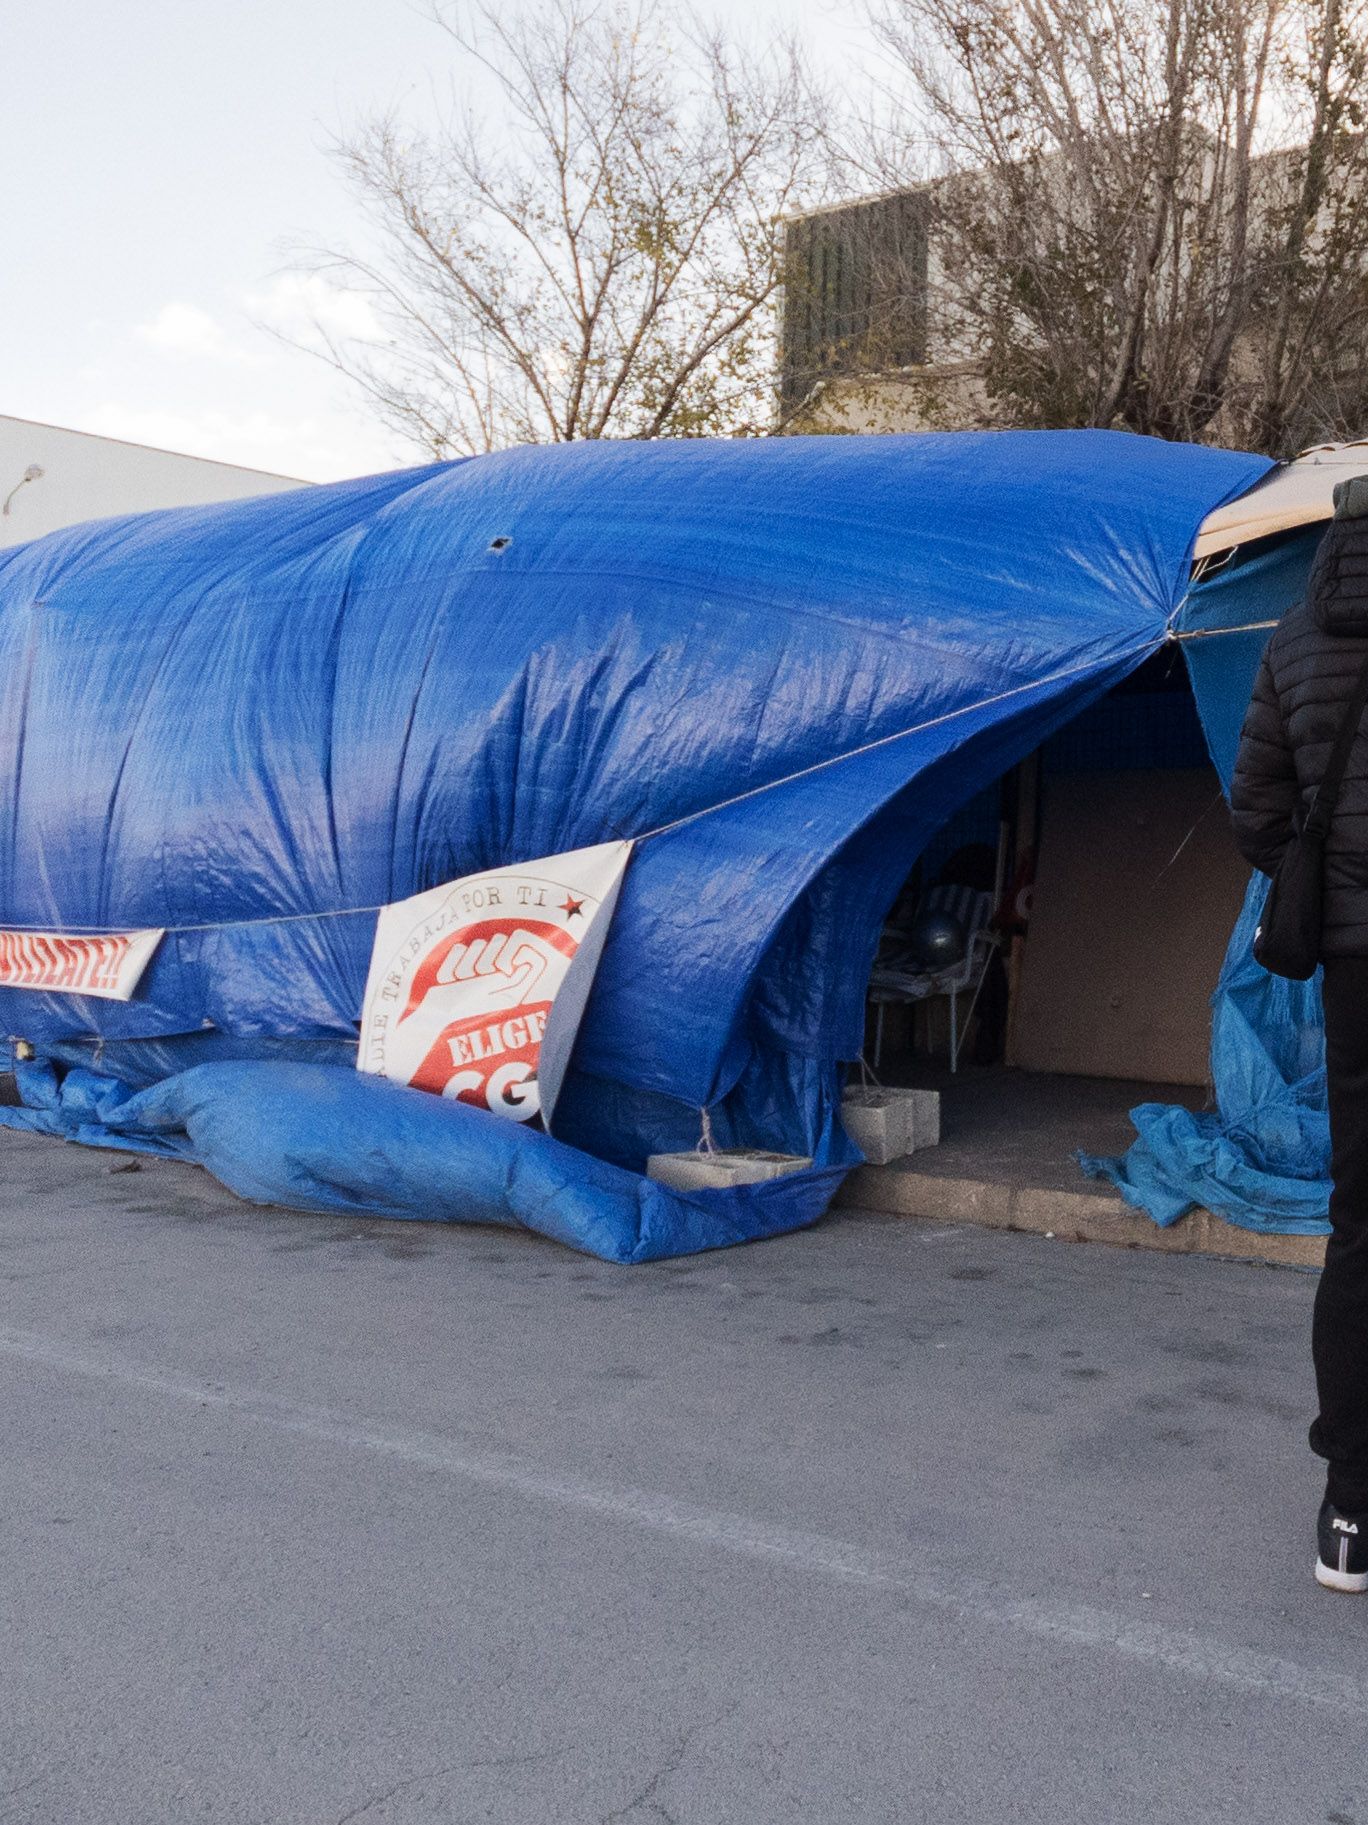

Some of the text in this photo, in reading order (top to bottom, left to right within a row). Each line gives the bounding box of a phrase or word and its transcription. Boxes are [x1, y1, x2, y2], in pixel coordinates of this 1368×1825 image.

[382, 903, 460, 1003] TRABAJA
[462, 886, 502, 913] POR
[516, 886, 548, 907] TI
[447, 1010, 548, 1067] ELIGE
[1333, 1519, 1358, 1534] FILA
